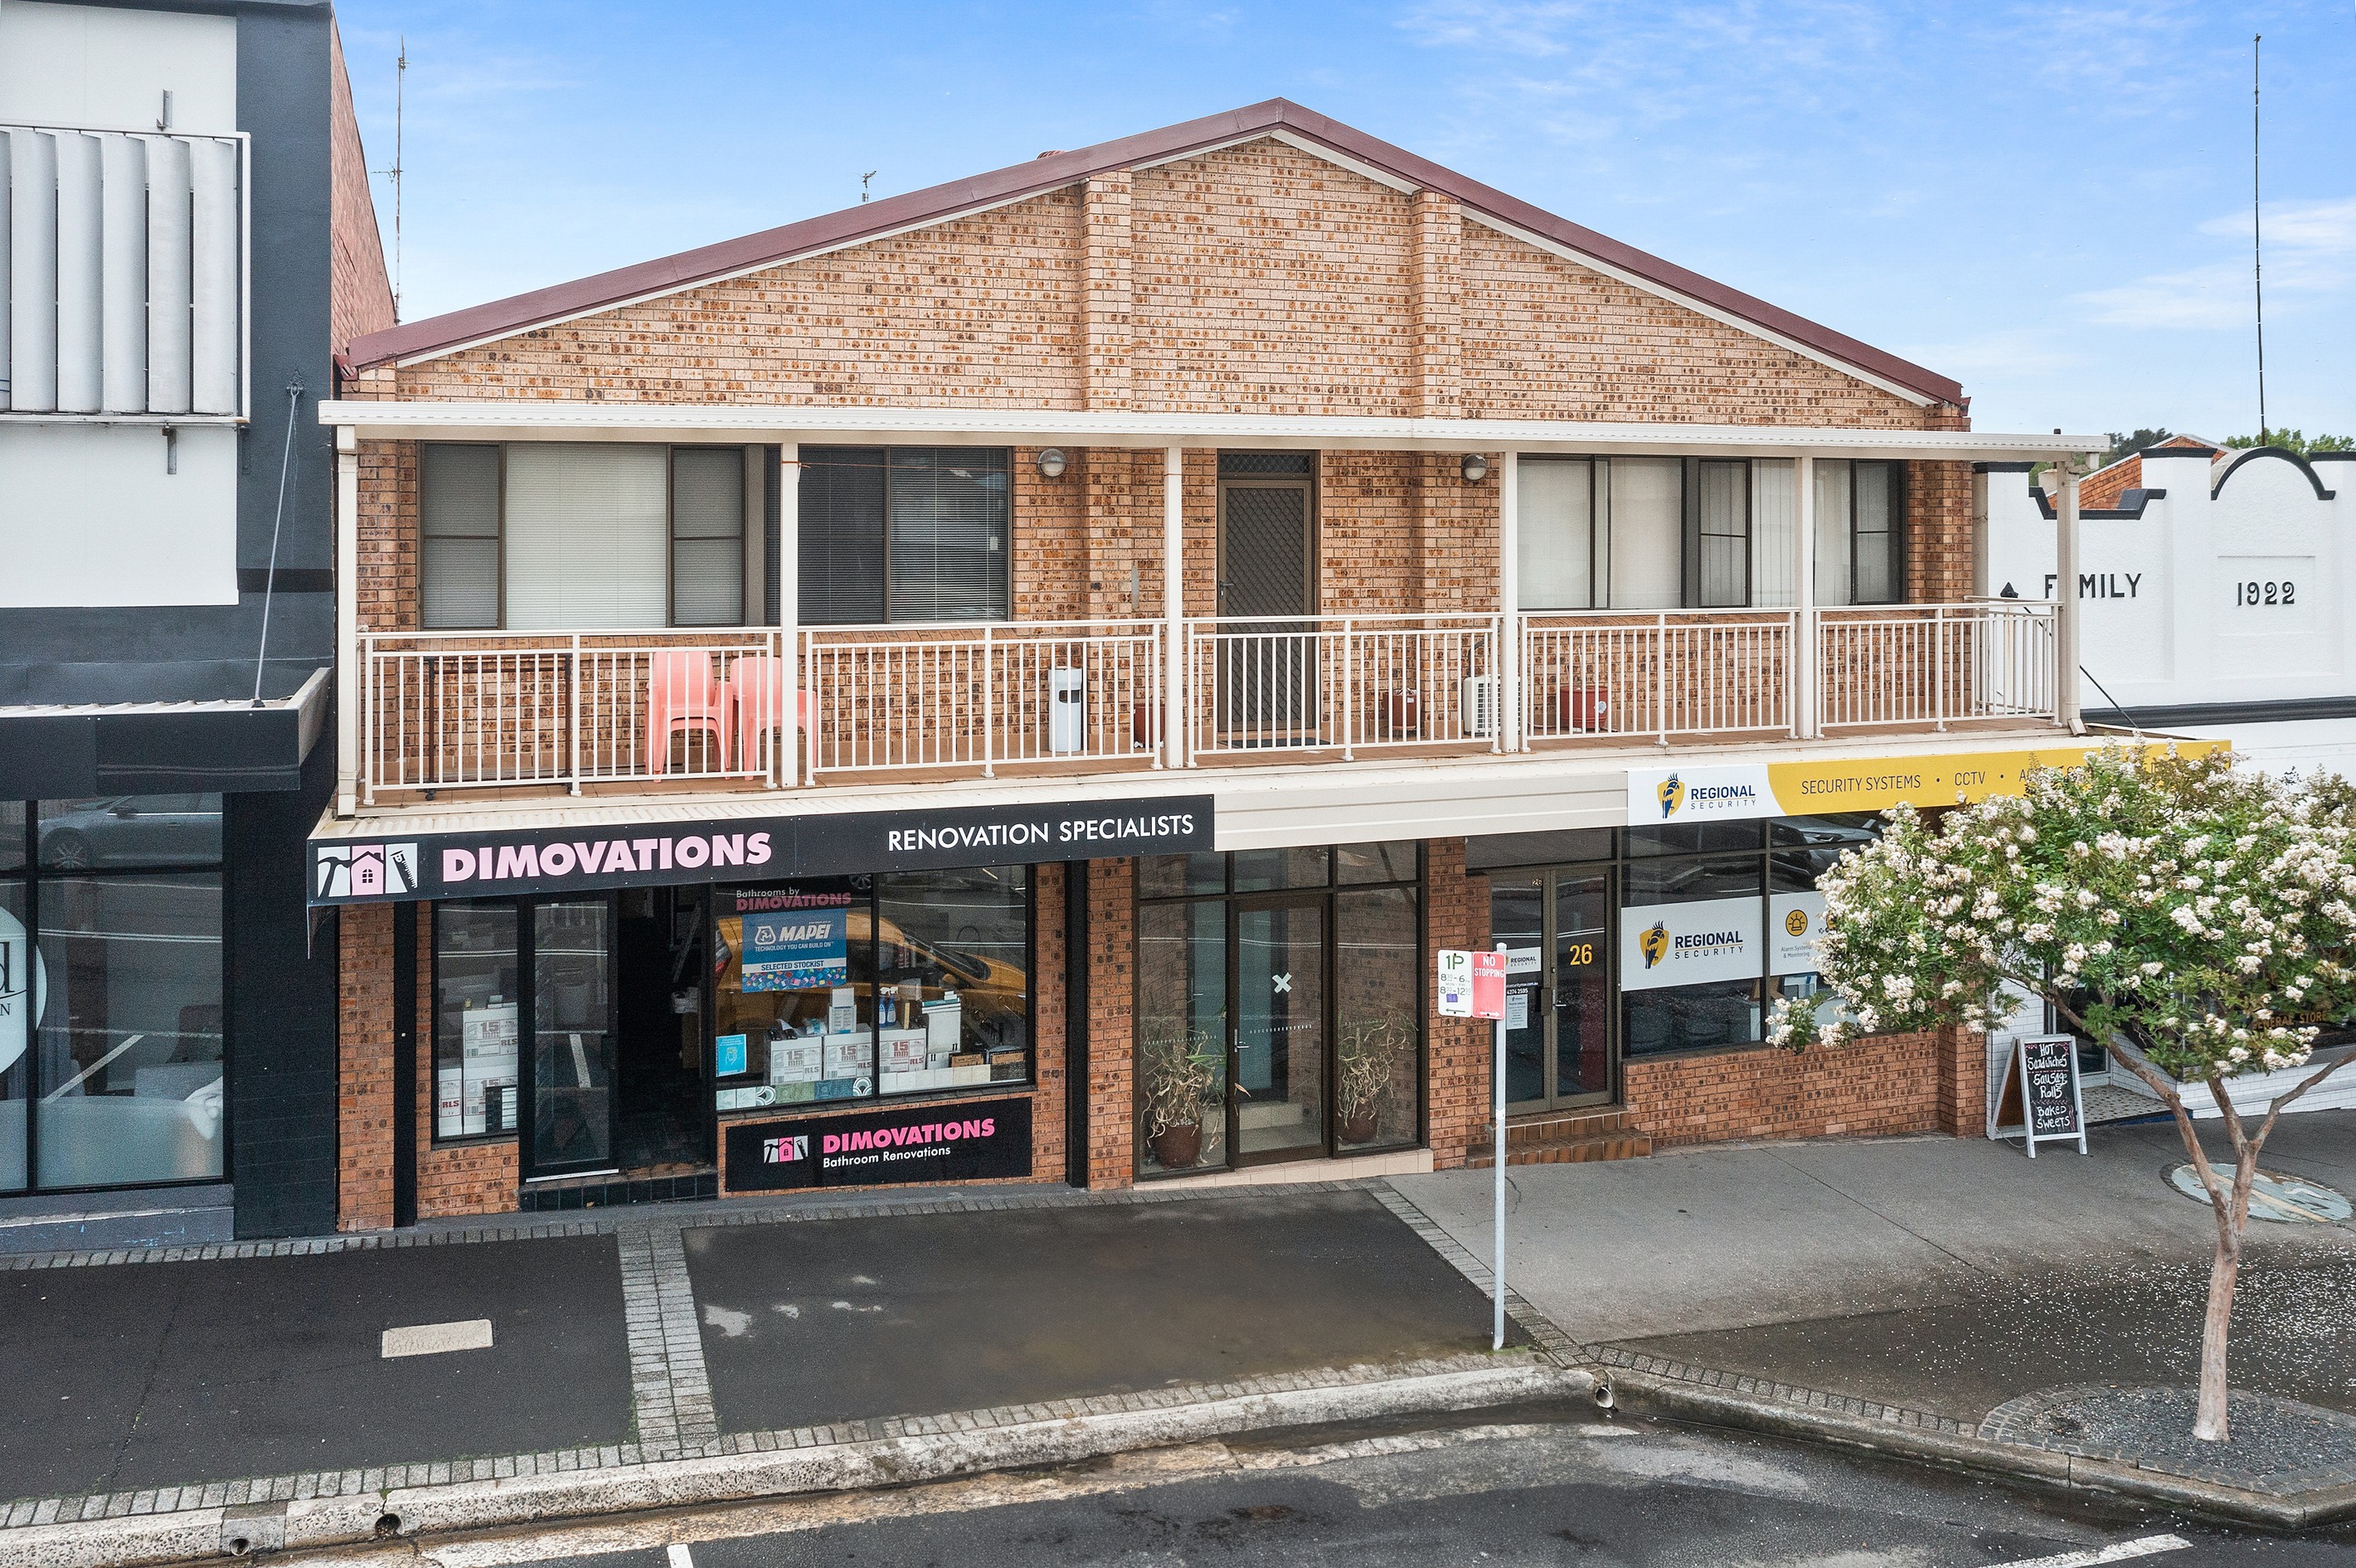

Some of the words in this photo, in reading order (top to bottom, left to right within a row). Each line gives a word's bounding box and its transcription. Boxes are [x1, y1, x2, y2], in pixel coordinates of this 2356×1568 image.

[2044, 573, 2142, 599] FMILY
[2237, 581, 2295, 606] 1922
[1801, 778, 1863, 794] SECURITY
[1866, 774, 1921, 790] SYSTEMS
[1954, 771, 1986, 786] CCTV
[1691, 785, 1756, 800] REGIONAL
[1690, 799, 1756, 809] SECURITY
[888, 823, 1048, 852] RENOVATION
[1059, 813, 1194, 842] SPECIALISTS
[443, 833, 772, 881] DIMOVATIONS
[736, 888, 786, 898] Bathrooms
[789, 887, 800, 896] by
[736, 892, 852, 911] DIMOVATIONS
[779, 925, 832, 942] MAPEI
[1674, 930, 1743, 949] REGIONAL
[1569, 944, 1592, 965] 26
[1674, 946, 1744, 959] SECURITY
[794, 960, 825, 968] STOCKIST
[1445, 954, 1465, 970] 1P
[1482, 956, 1496, 966] NO
[1474, 968, 1504, 978] STOPPING
[480, 1022, 499, 1032] 15
[2255, 1014, 2294, 1028] ENERAL
[500, 1038, 517, 1046] RLS
[892, 1041, 909, 1051] 15
[786, 1051, 804, 1060] 15
[839, 1046, 857, 1056] 15
[2039, 1043, 2055, 1057] HOT
[804, 1066, 819, 1074] RLS
[857, 1061, 872, 1070] RLS
[442, 1100, 459, 1109] RLS
[823, 1119, 995, 1153] DIMOVATIONS
[823, 1154, 879, 1168] Bathroom
[882, 1146, 951, 1162] Renovations
